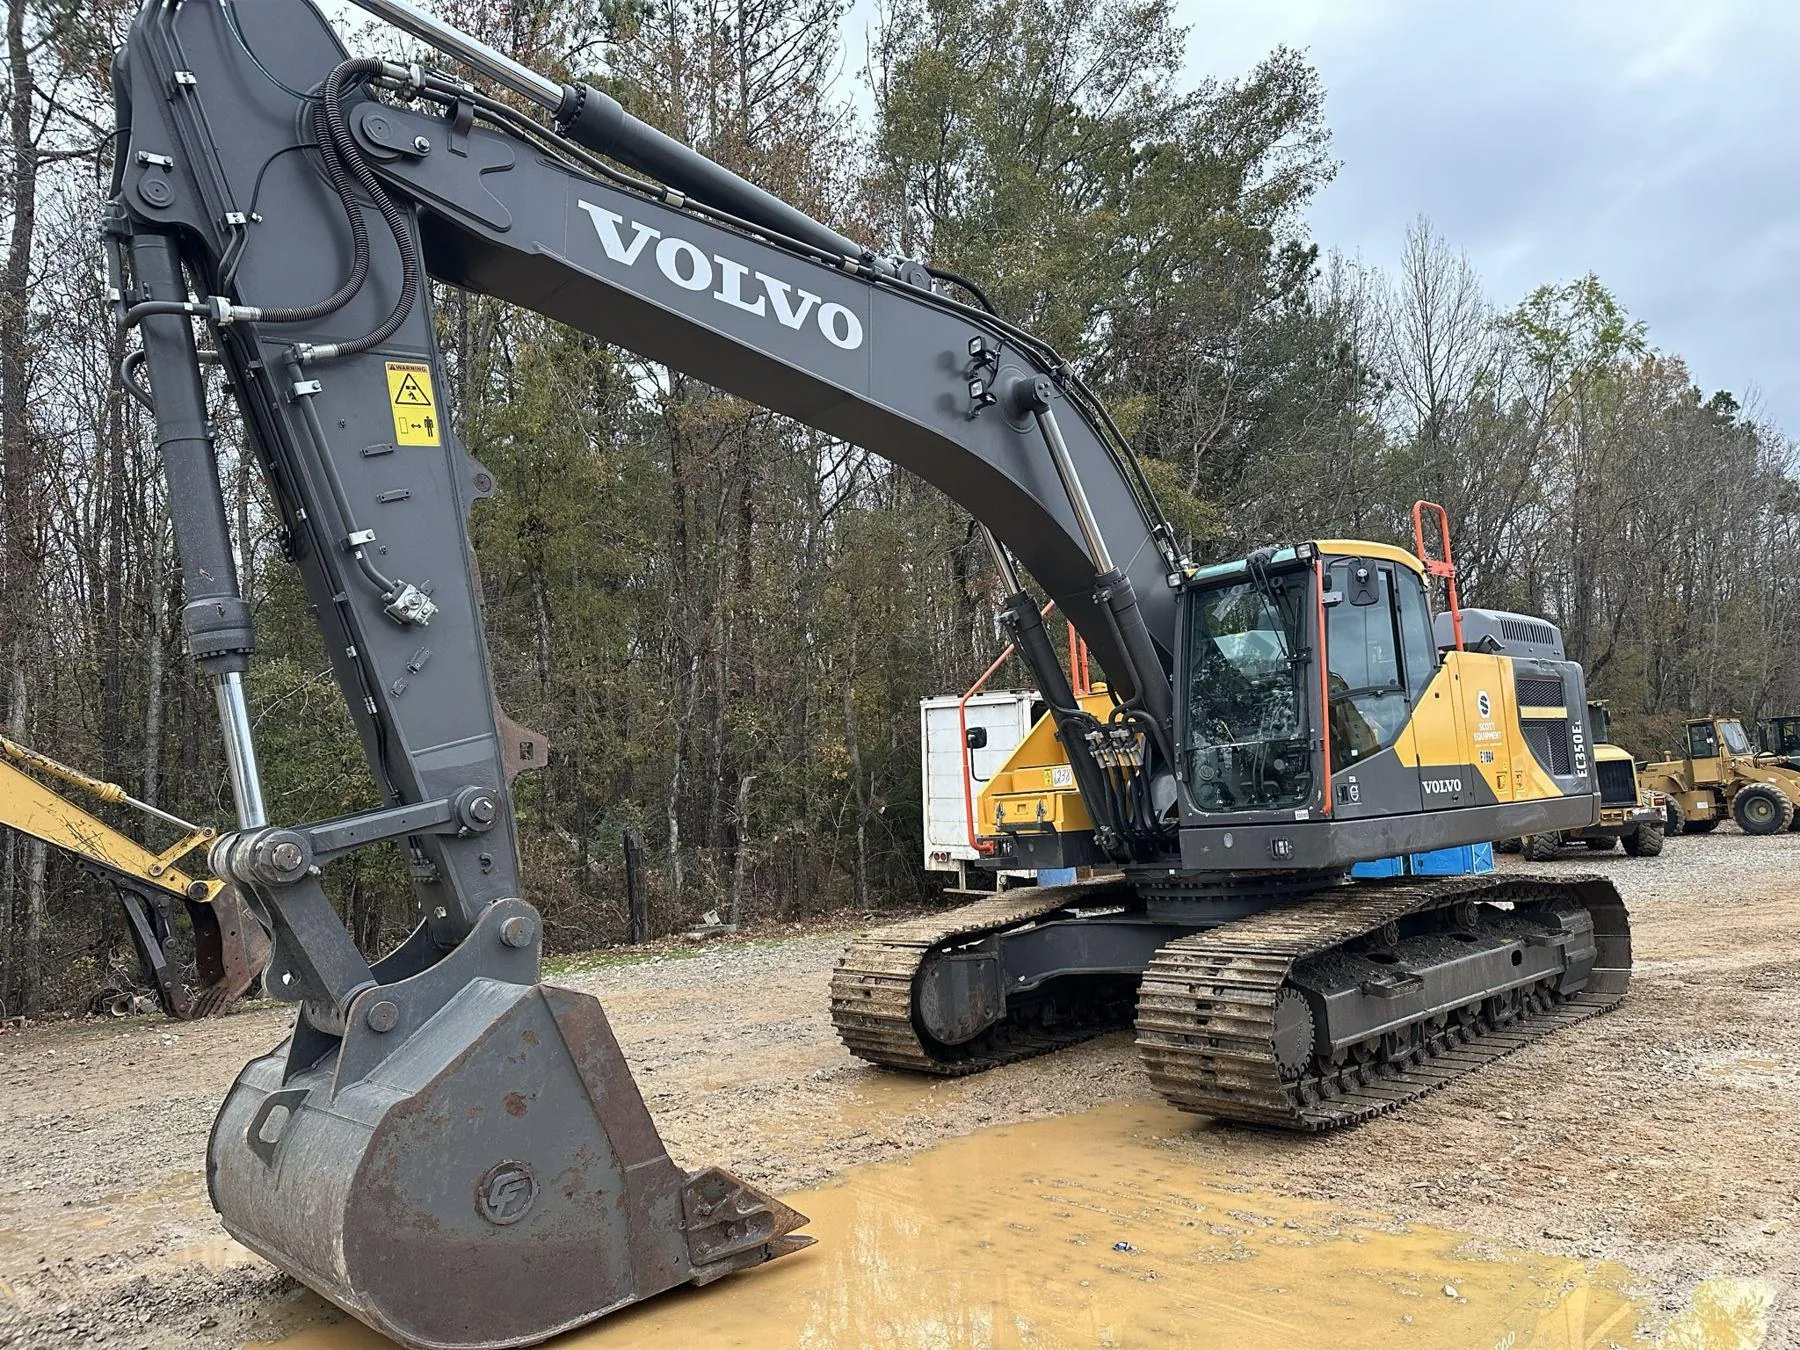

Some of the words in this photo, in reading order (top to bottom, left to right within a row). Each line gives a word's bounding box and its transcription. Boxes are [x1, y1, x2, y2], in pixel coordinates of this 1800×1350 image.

[577, 199, 863, 350] VOLVO
[396, 364, 426, 372] WARNING
[1474, 731, 1501, 741] EQUIPMENT
[1422, 779, 1461, 794] VOLVO
